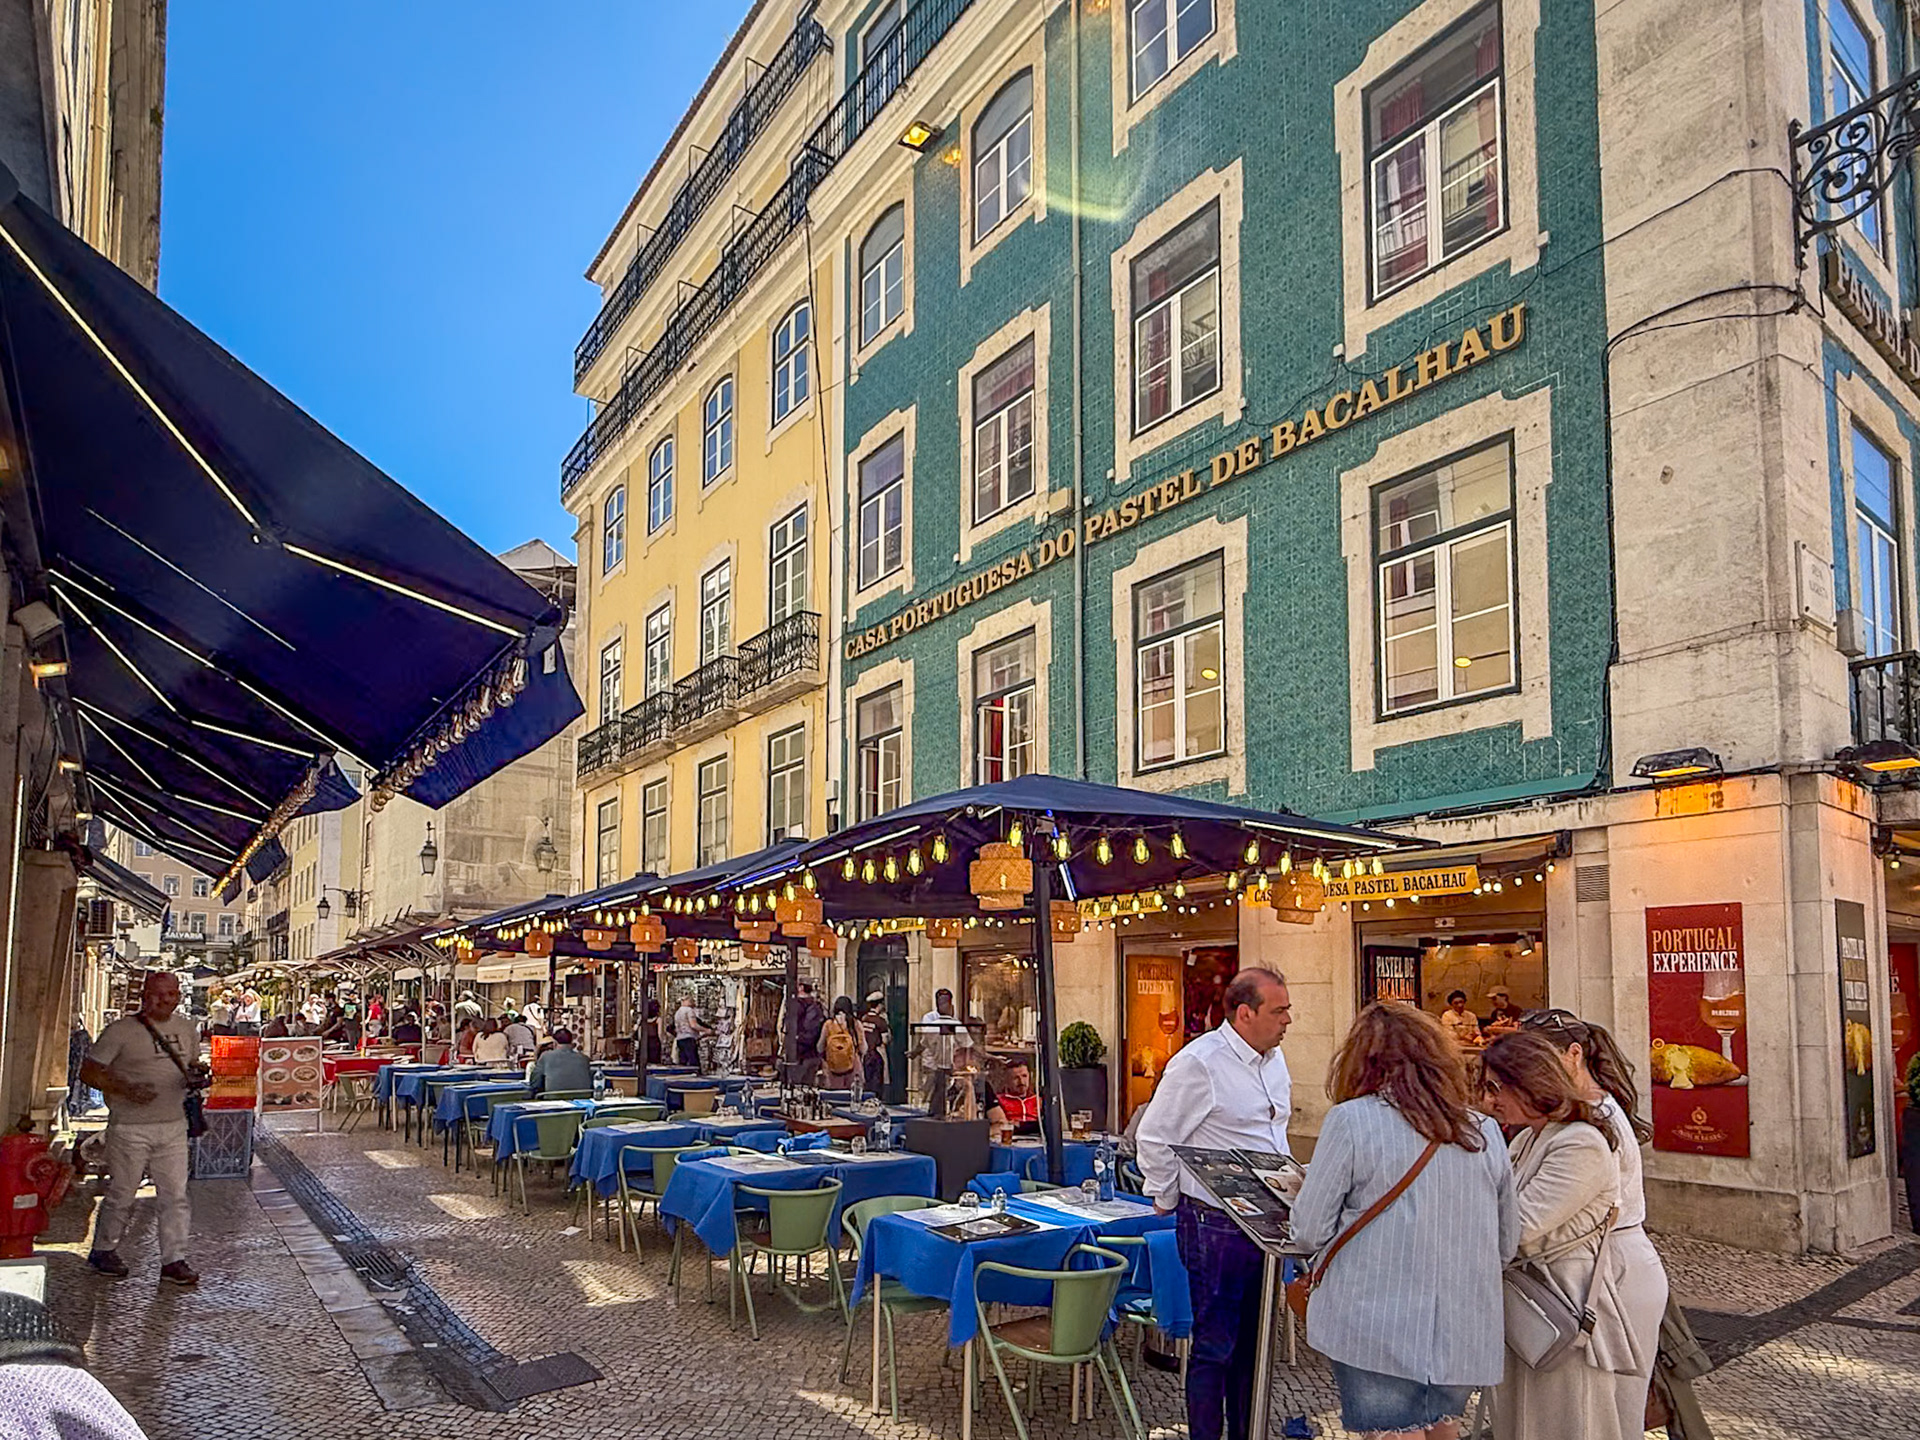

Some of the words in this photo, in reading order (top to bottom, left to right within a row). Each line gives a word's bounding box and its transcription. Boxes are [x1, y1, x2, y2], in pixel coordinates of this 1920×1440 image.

[1838, 250, 1907, 367] PASTEL
[845, 626, 888, 660] CASA
[890, 557, 1034, 638] PORTUGUESA
[1039, 529, 1076, 569] DO
[1083, 467, 1201, 543] PASTEL
[1210, 437, 1263, 488] DE
[1271, 301, 1527, 459] BACALHAU
[1354, 878, 1399, 896] PASTEL
[1403, 871, 1468, 892] BACALHAU
[1652, 927, 1737, 952] PORTUGAL
[1376, 956, 1403, 977] PASTEL
[1404, 957, 1415, 978] DE
[1653, 951, 1738, 973] EXPERIENCE
[1376, 978, 1415, 999] BACALHAU
